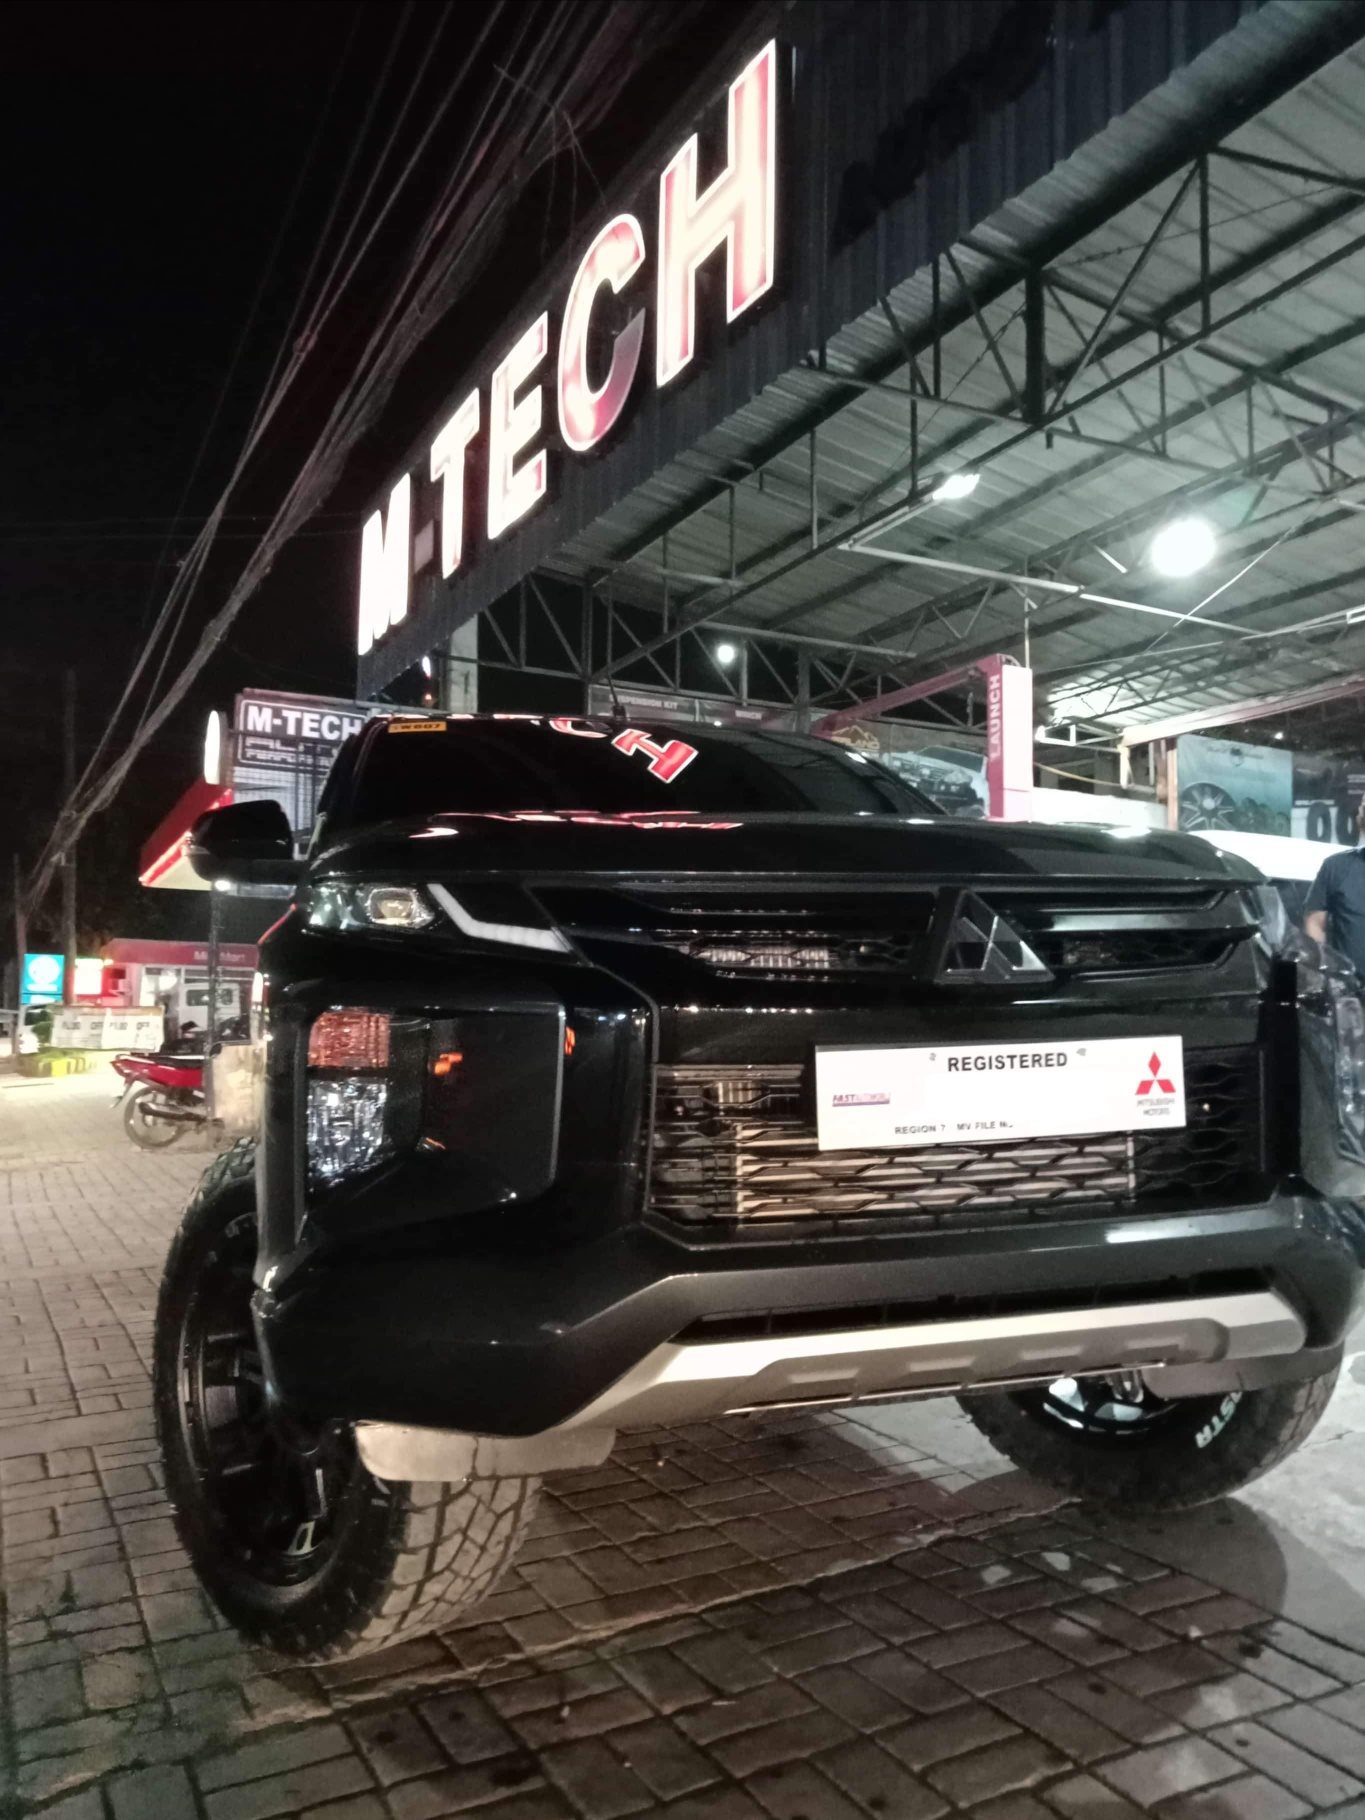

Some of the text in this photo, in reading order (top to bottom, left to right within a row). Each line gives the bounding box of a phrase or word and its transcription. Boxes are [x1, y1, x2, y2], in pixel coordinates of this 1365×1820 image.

[357, 38, 777, 656] M-TECH
[609, 694, 663, 708] SSPENSION
[246, 705, 362, 741] M-TECH
[989, 673, 1001, 760] LAUNCH
[947, 1052, 1068, 1072] REGISTERED
[894, 1125, 937, 1134] REGION
[957, 1123, 971, 1131] MV
[975, 1121, 996, 1130] FILE
